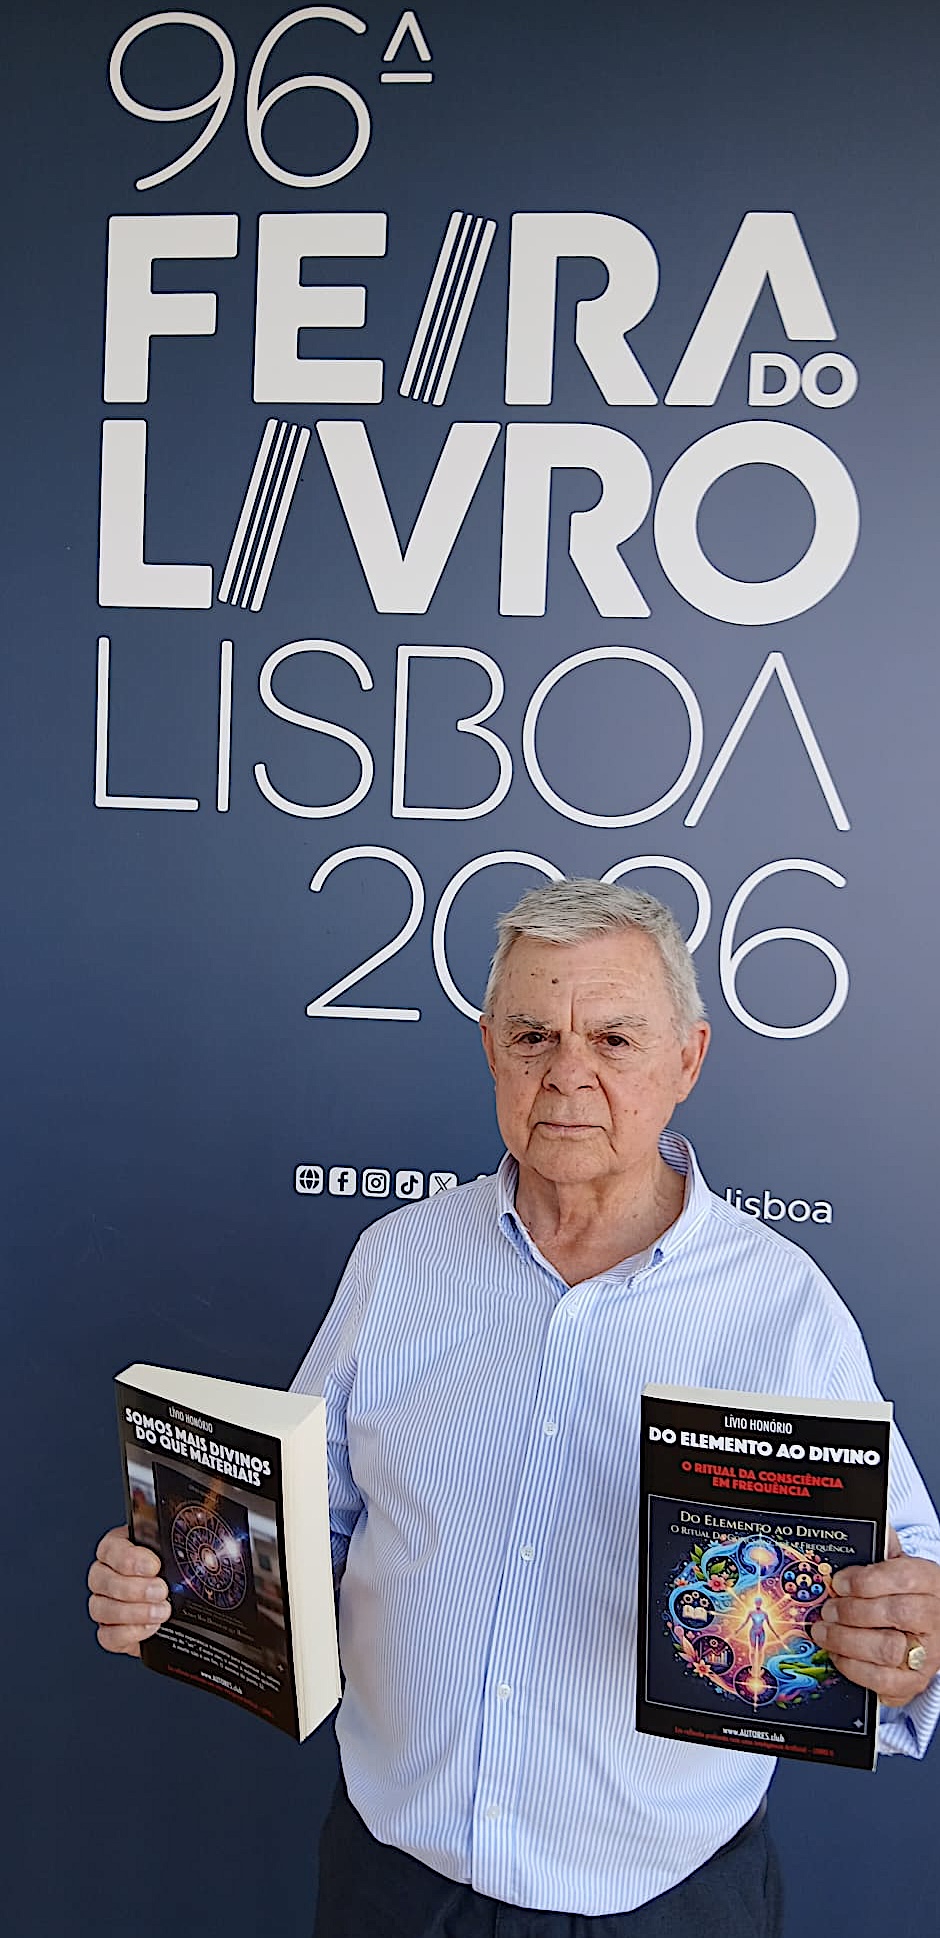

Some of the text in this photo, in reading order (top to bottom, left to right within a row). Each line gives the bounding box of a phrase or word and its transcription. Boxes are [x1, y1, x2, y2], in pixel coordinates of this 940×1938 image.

[102, 210, 838, 406] FEIRA
[748, 351, 859, 408] DO
[97, 418, 861, 626] LIVRO
[95, 636, 851, 831] LISBOA
[125, 1407, 271, 1476] SOMOS MAIS DIVINOS
[648, 1426, 881, 1466] DO ELEMENTO AO DIVINO
[724, 1413, 793, 1435] LÍVIO HONÓRIO
[135, 1426, 261, 1487] DO QUE MATERIAIS
[681, 1461, 845, 1489] O RITUAL DA CONSCIÊNCIA
[712, 1477, 811, 1497] EM FREQUÊNCIA
[670, 1524, 680, 1533] O
